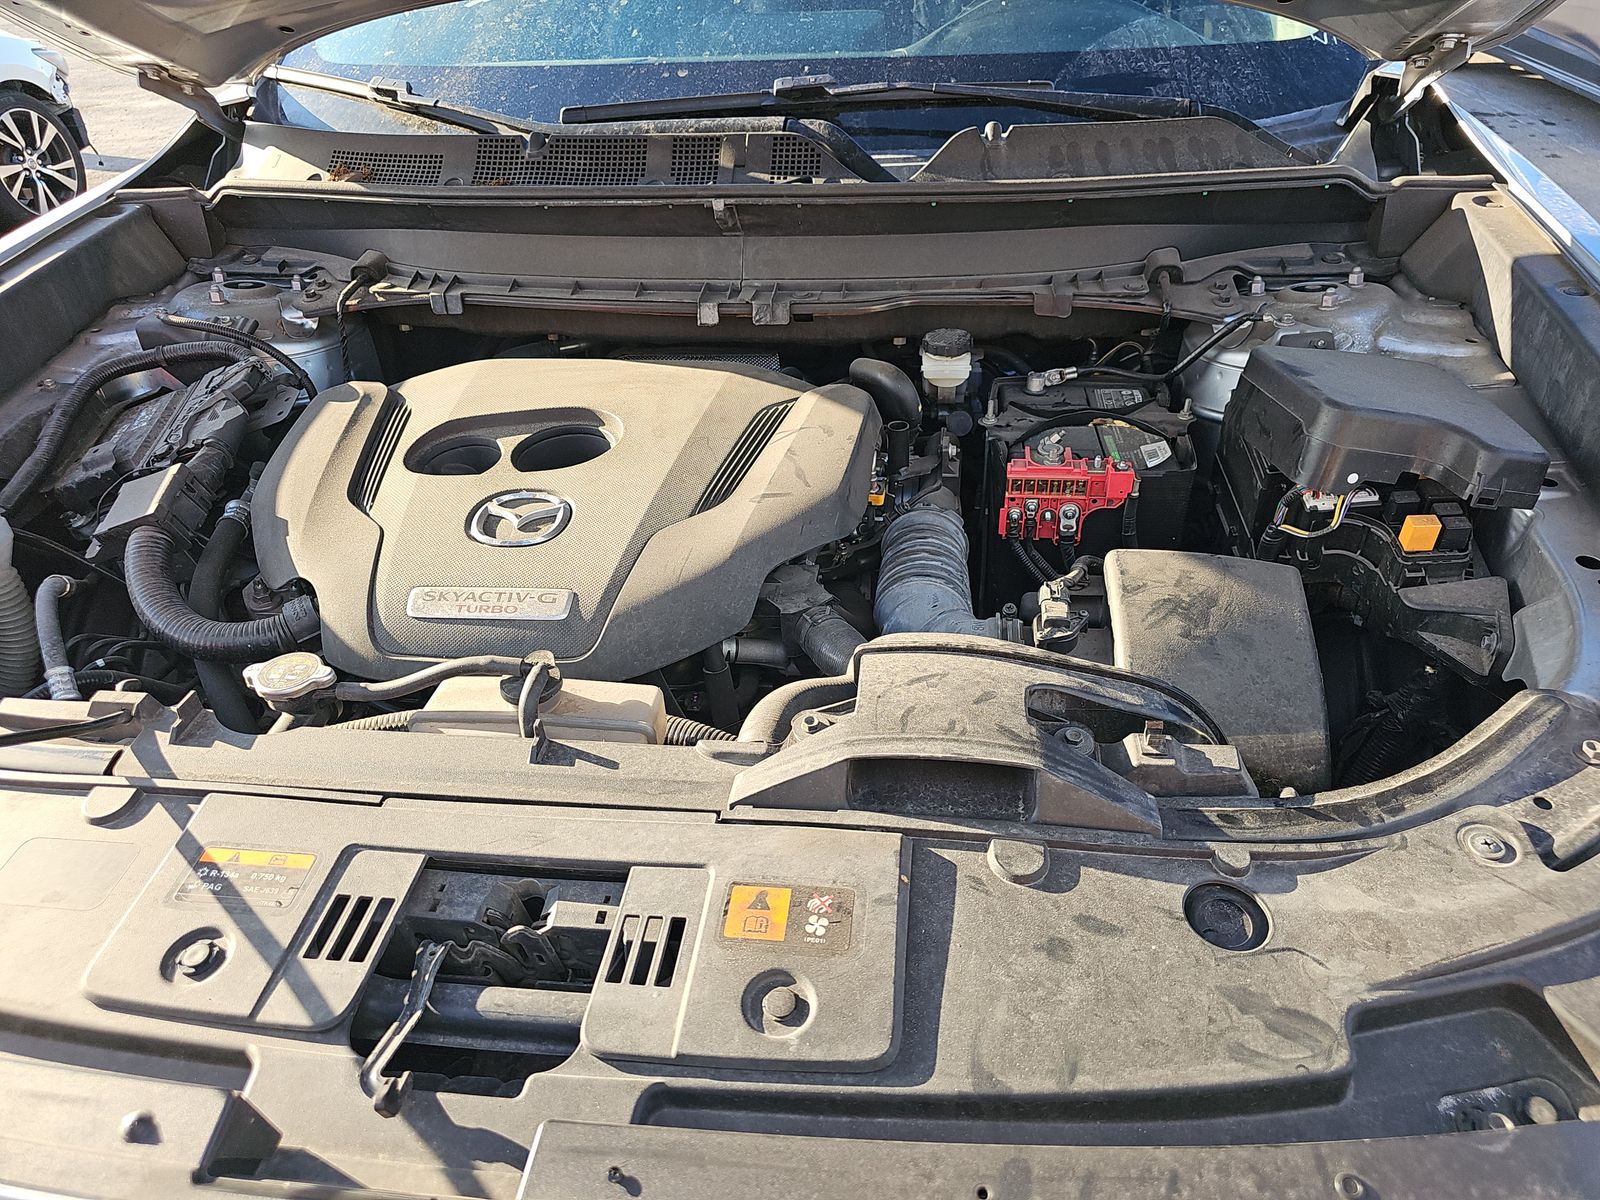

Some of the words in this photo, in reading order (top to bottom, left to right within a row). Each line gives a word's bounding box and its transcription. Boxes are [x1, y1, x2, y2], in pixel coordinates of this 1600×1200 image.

[422, 590, 558, 604] SKYACTIV-G
[455, 604, 518, 614] TURBO
[210, 869, 239, 878] R-134a
[275, 874, 287, 883] kg
[201, 882, 223, 891] PAG
[242, 885, 261, 893] SAE
